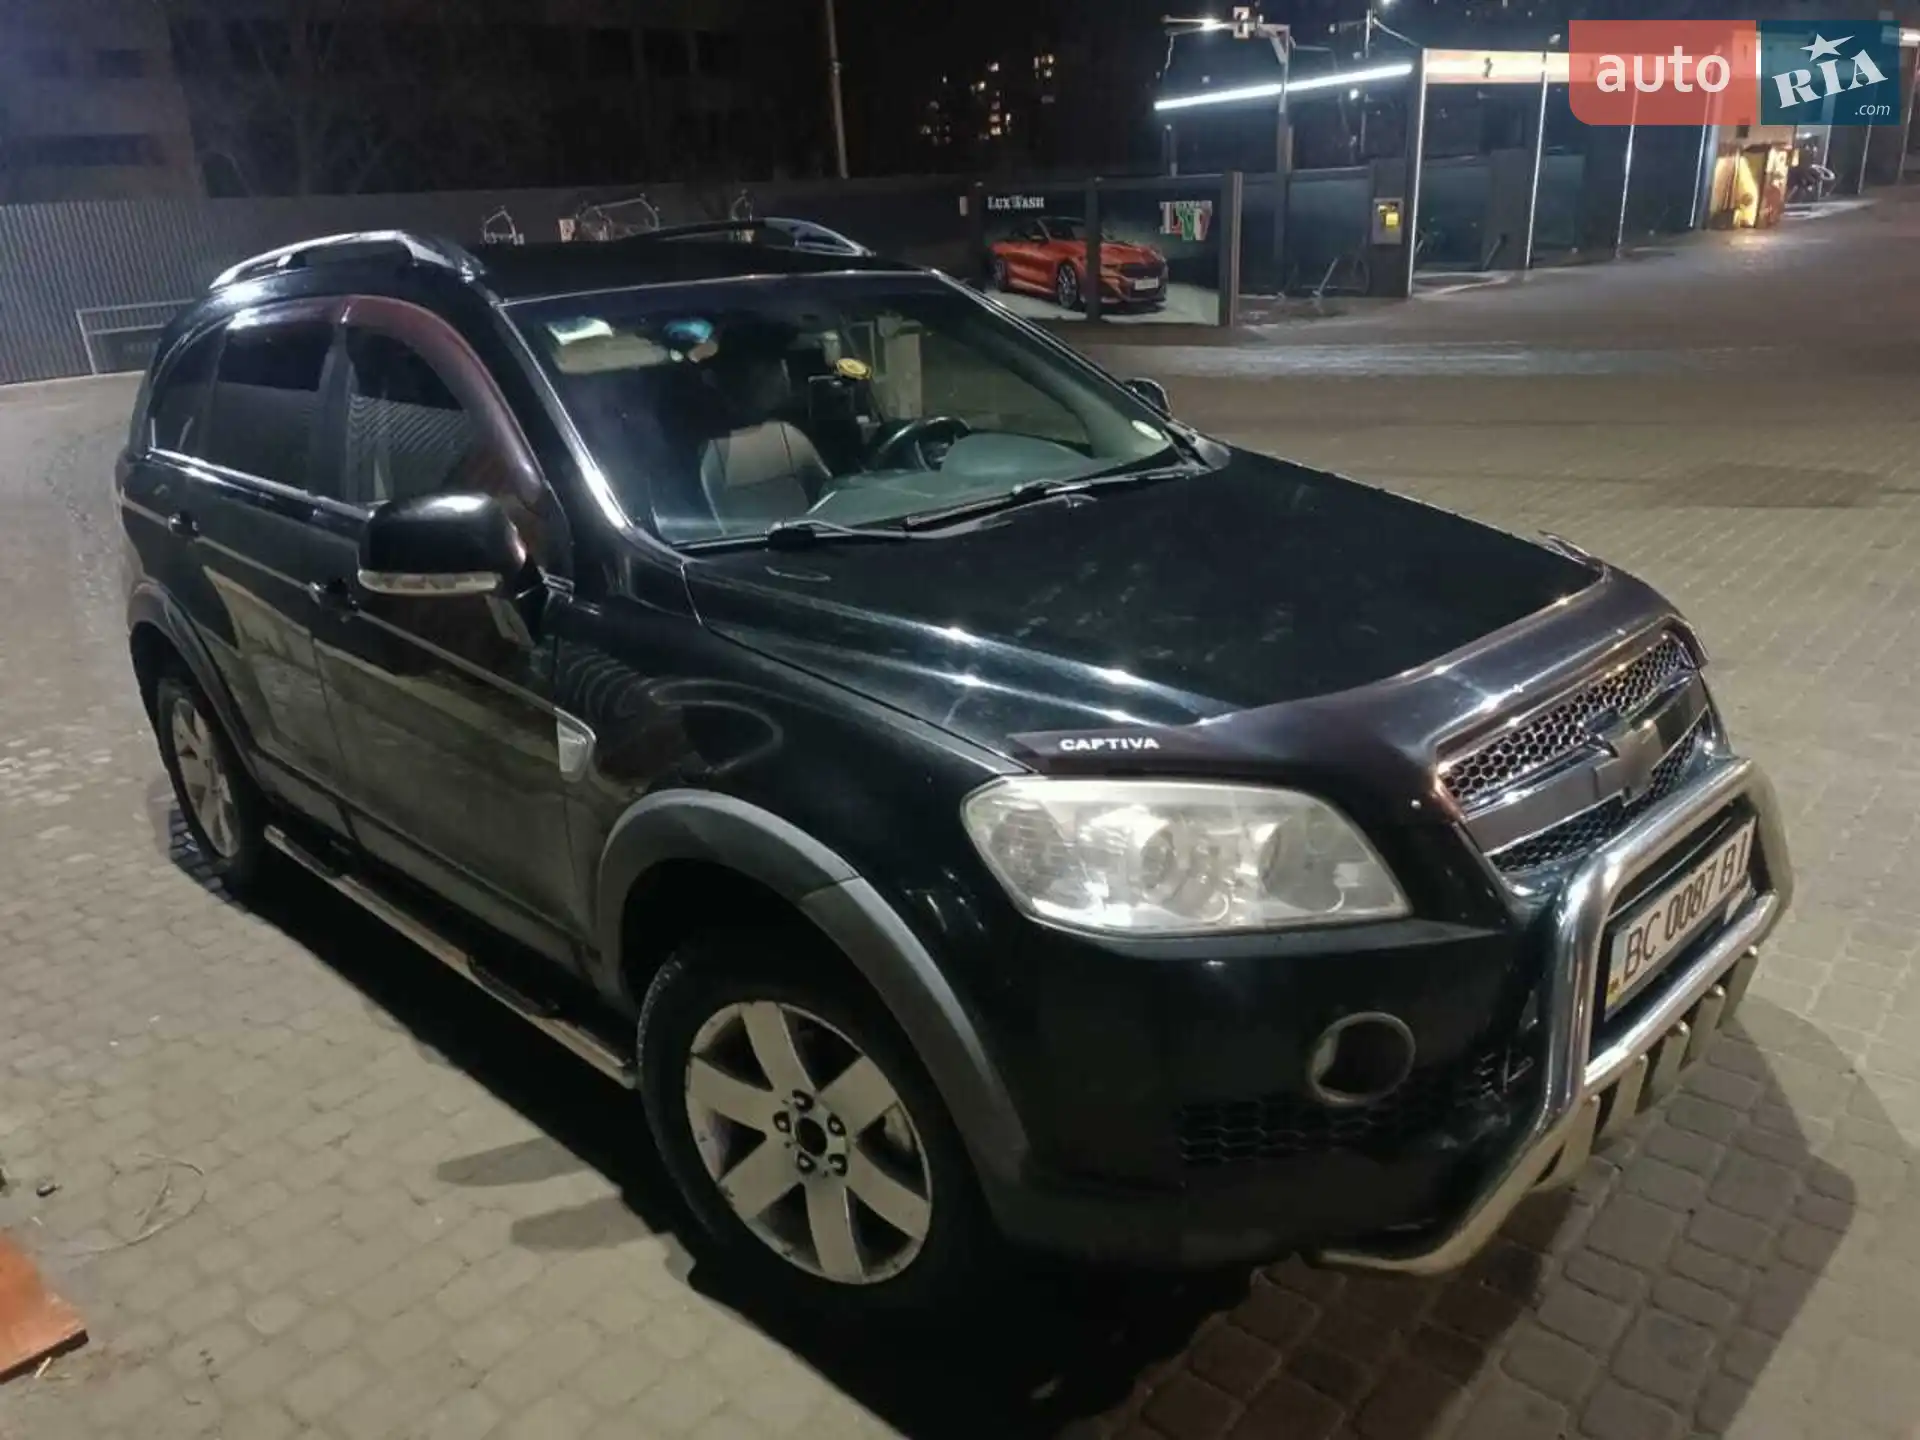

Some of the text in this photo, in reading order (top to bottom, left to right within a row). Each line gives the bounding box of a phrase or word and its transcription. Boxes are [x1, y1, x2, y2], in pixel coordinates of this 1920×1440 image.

[1060, 738, 1160, 750] CAPTIVA
[1624, 832, 1749, 980] BC 0087 BI
